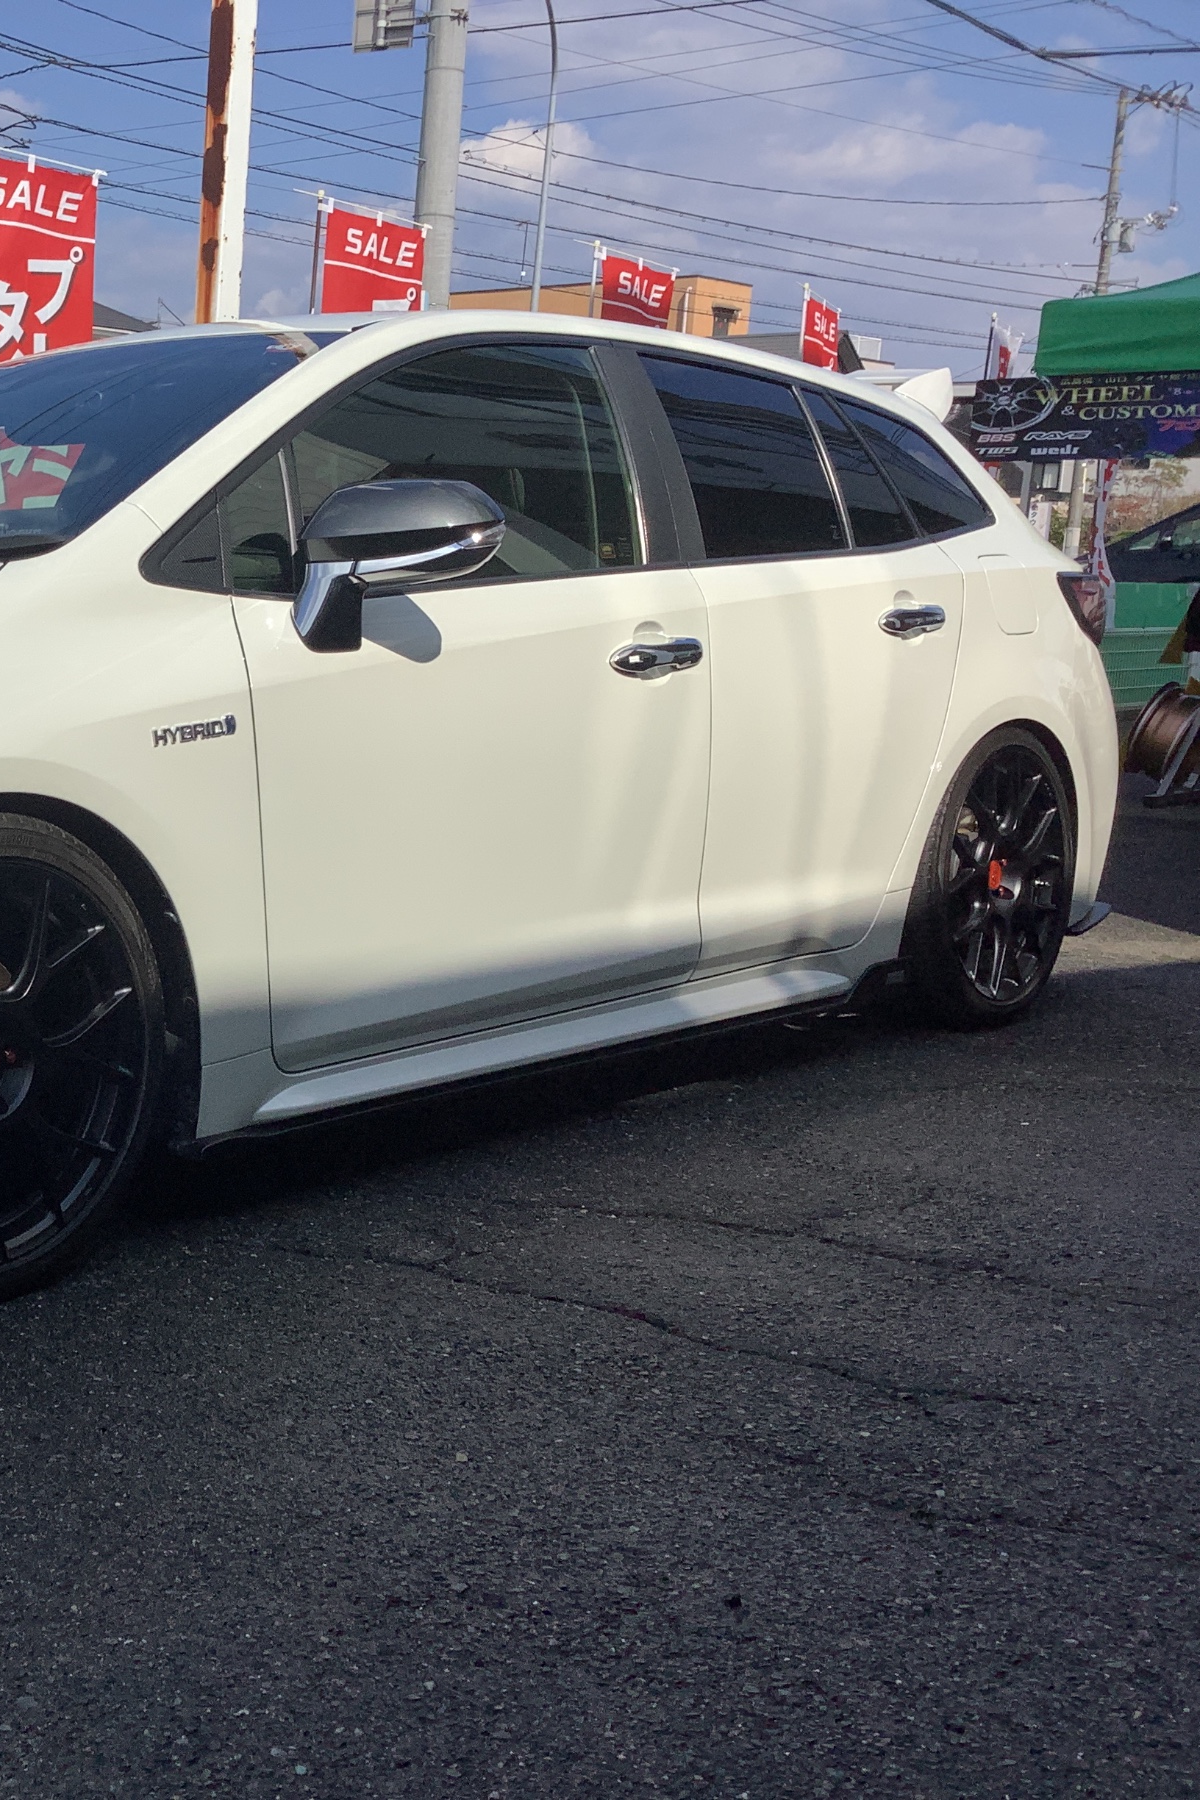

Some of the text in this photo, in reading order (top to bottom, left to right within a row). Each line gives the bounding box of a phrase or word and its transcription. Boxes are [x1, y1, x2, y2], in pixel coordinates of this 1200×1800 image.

[345, 227, 419, 269] SALE
[618, 271, 667, 308] SALE
[813, 311, 836, 343] SALE
[1034, 384, 1164, 405] WHEEL
[1061, 403, 1200, 420] & CUSTOM
[977, 429, 1092, 443] BBS RAYS
[151, 718, 226, 748] HYBRID
